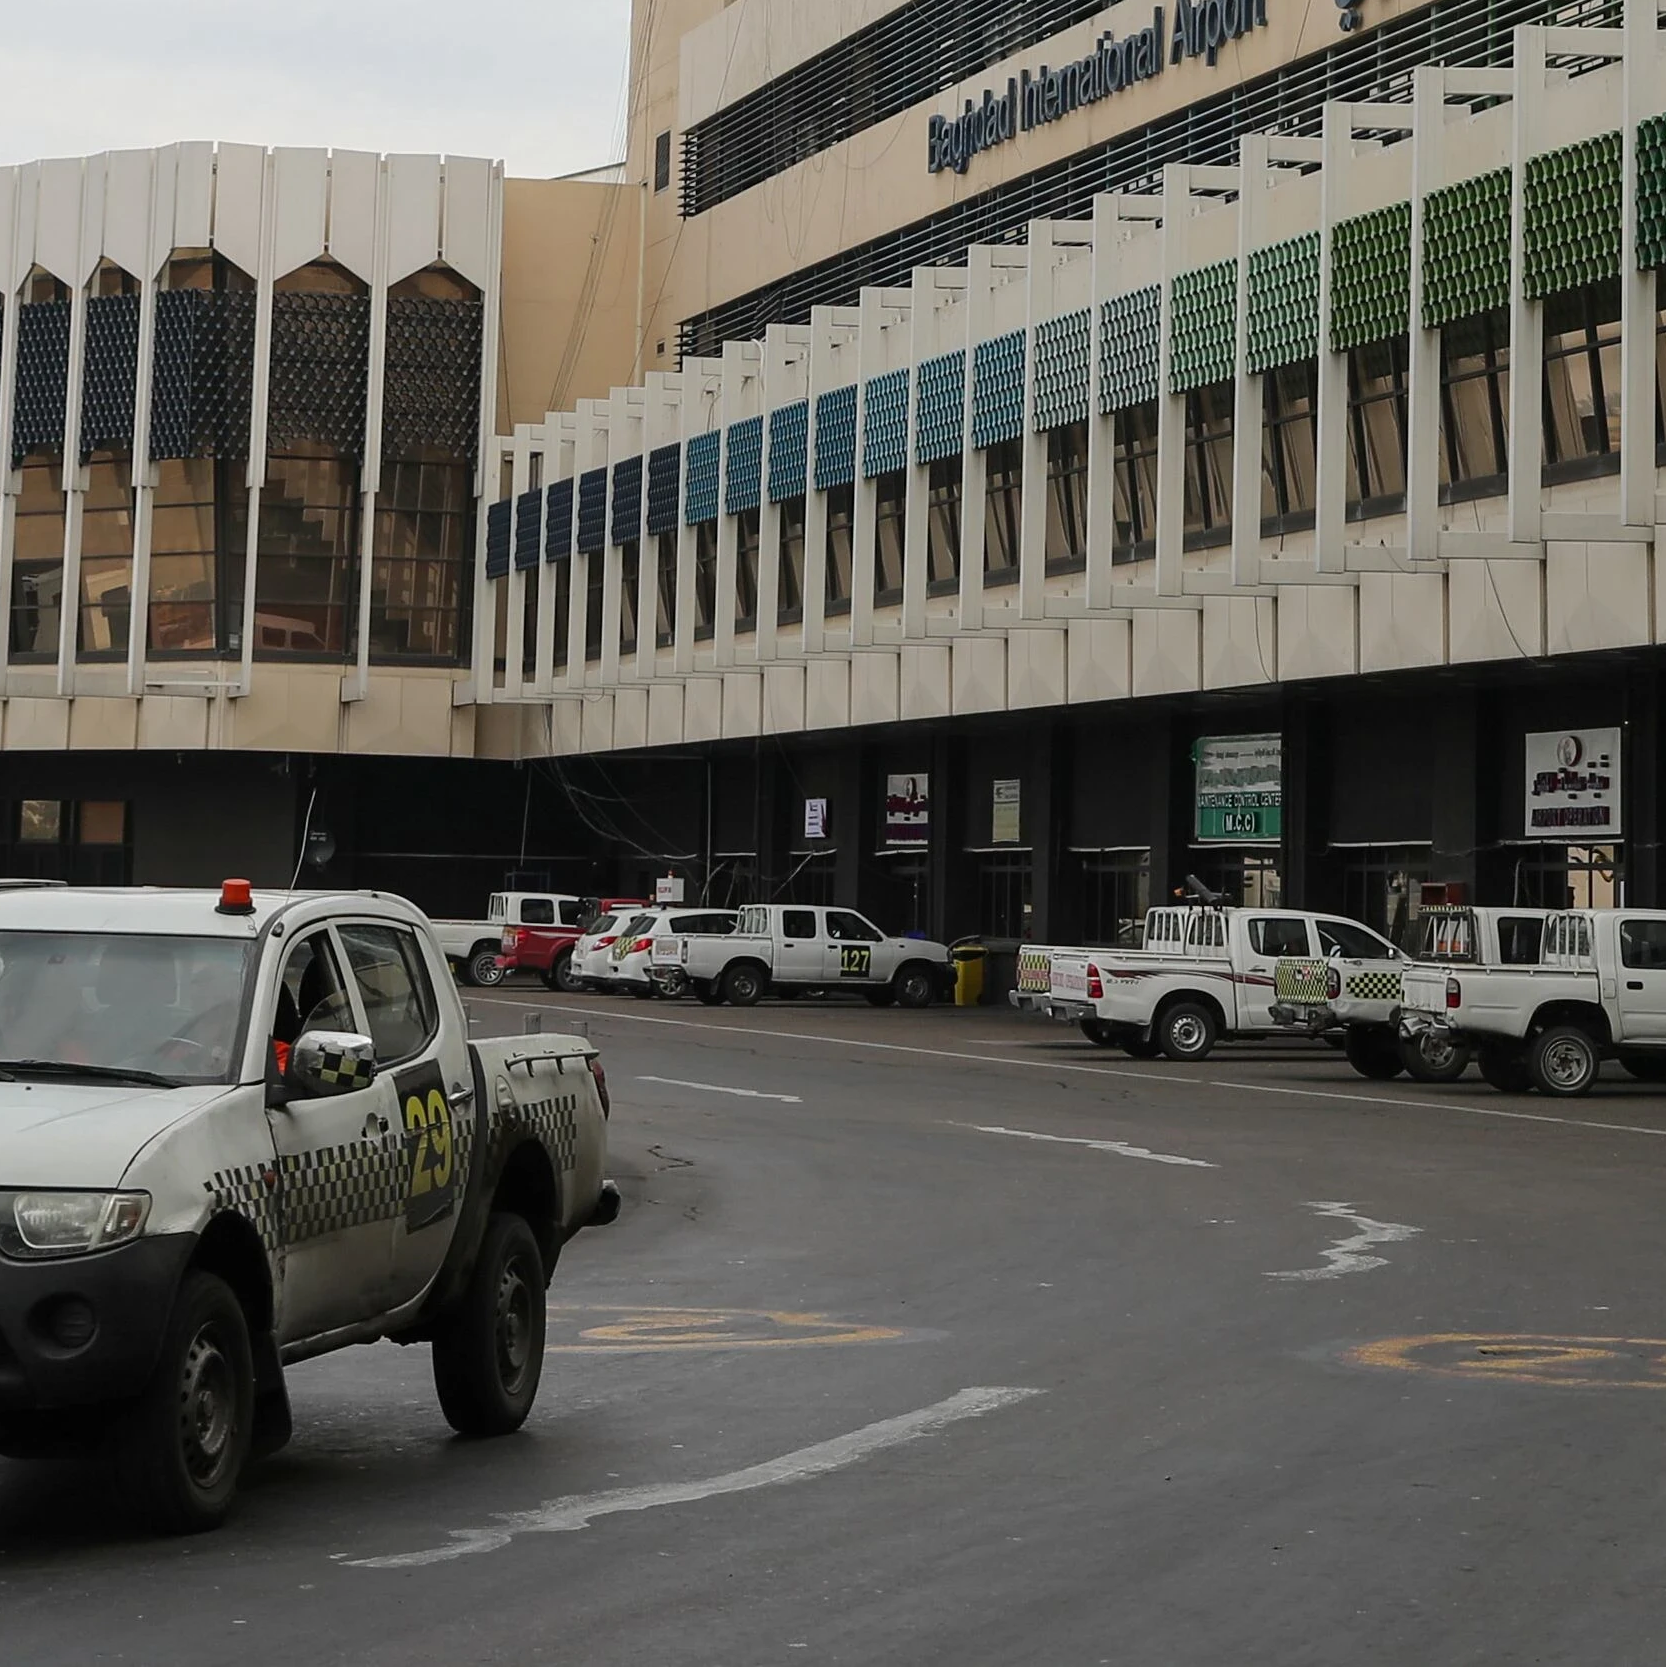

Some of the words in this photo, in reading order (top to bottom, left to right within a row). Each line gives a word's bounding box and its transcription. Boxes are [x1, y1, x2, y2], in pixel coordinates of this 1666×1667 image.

[928, 77, 1017, 175] Baghdad
[1020, 5, 1165, 132] International
[841, 950, 869, 971] 127
[406, 1089, 452, 1197] 29
